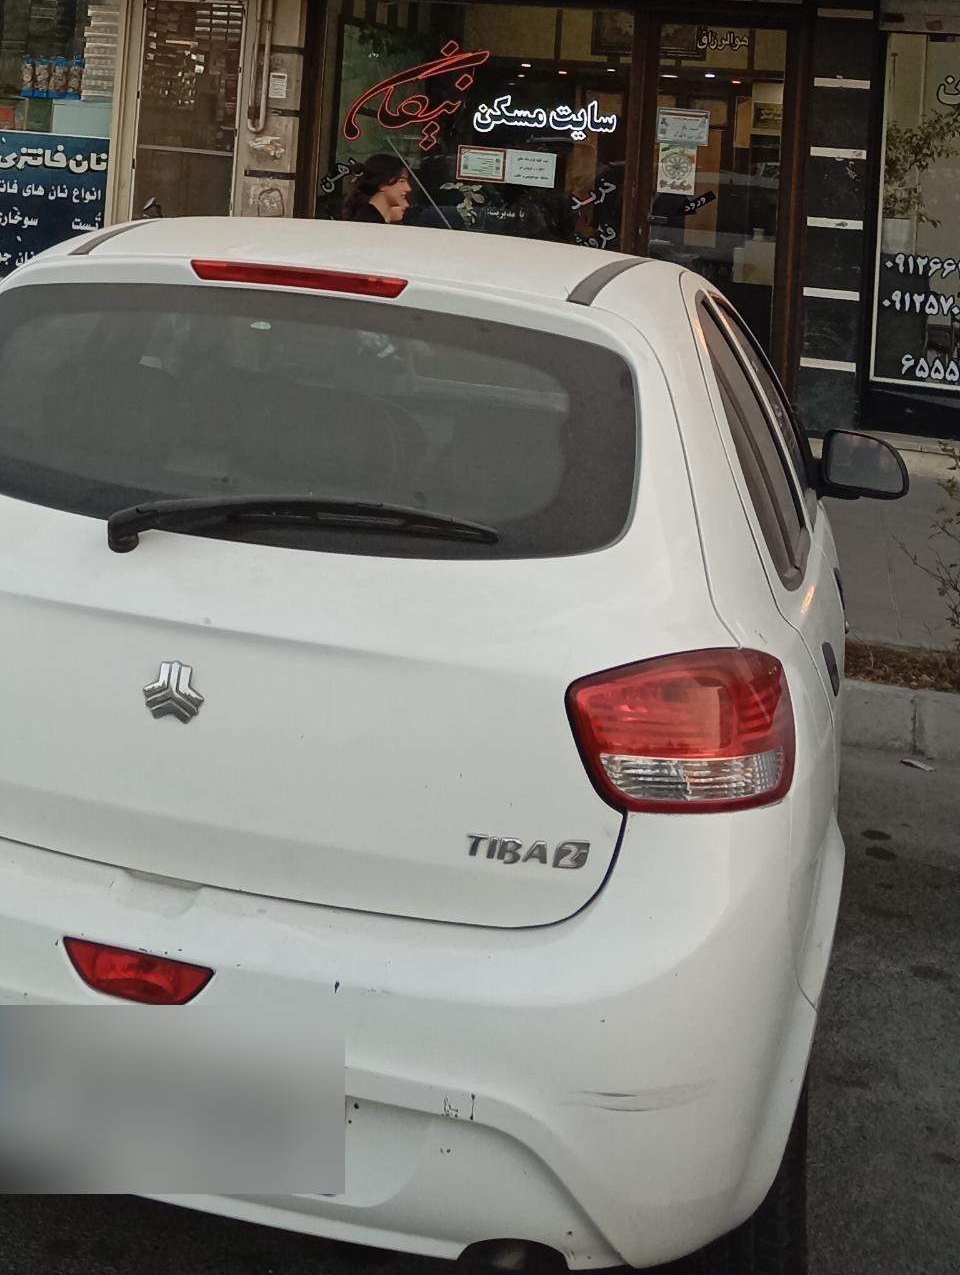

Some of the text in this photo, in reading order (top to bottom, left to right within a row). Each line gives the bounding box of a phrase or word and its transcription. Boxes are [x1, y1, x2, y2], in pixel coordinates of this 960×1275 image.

[472, 94, 547, 134] مسکن
[548, 100, 618, 141] سایت
[68, 151, 108, 174] نان
[22, 182, 45, 197] های
[48, 184, 69, 201] نان
[72, 186, 101, 204] انواع
[570, 177, 617, 211] خرید
[465, 832, 592, 871] TIBA 2
